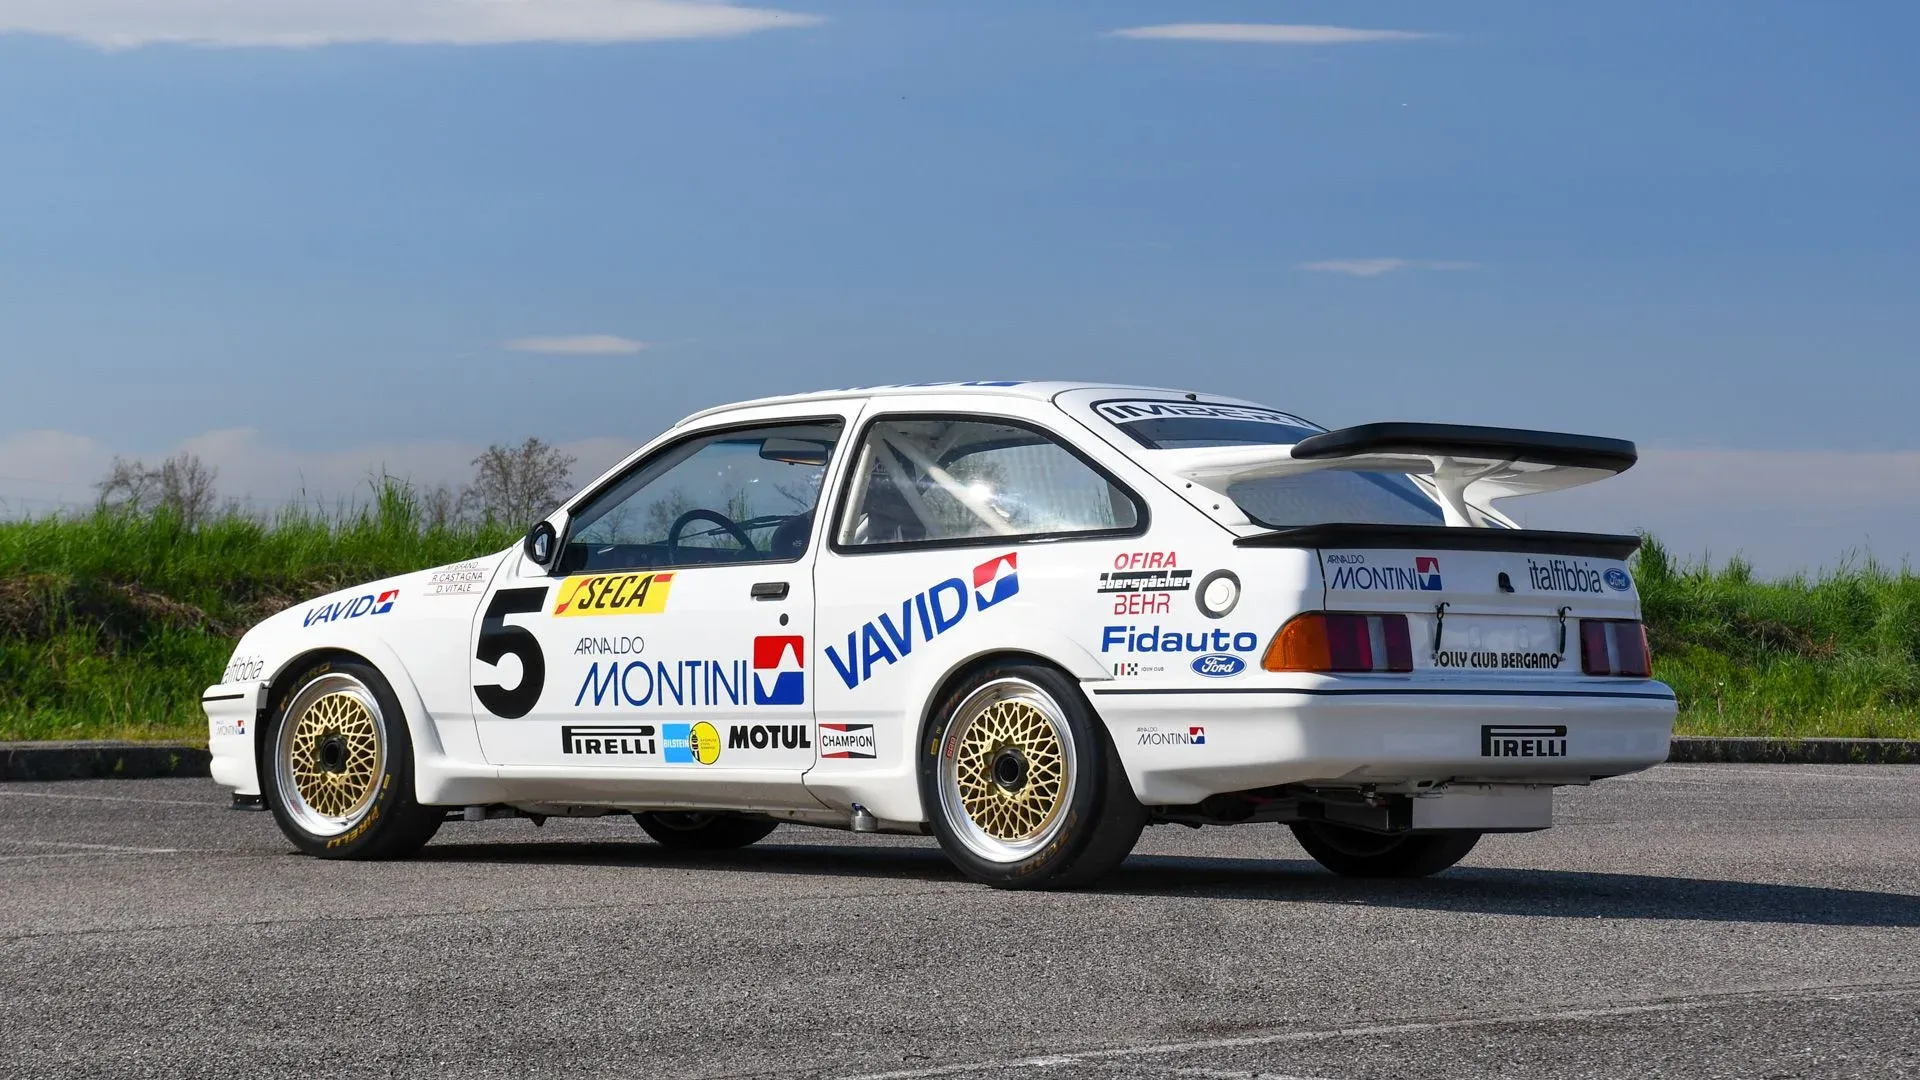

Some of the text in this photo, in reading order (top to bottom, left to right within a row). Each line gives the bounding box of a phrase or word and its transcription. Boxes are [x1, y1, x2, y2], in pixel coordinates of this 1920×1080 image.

[1114, 551, 1177, 570] OFIRA
[1326, 554, 1365, 564] ARNALDO
[1331, 566, 1418, 591] MONTINI
[1527, 558, 1604, 593] italfibbia
[577, 574, 655, 610] SECA
[1114, 593, 1171, 615] BEHR
[303, 594, 375, 628] VAVID
[574, 636, 645, 654] ARNALDO
[824, 577, 968, 690] VAVID
[1101, 625, 1258, 653] Fidauto
[473, 585, 550, 720] 5
[1470, 652, 1498, 669] CLUB
[1501, 652, 1560, 669] BERGAMO
[574, 660, 748, 707] MONTINI
[561, 725, 656, 755] PIRELLI
[728, 725, 812, 749] MOTUL
[822, 735, 873, 748] CHAMPION
[1137, 732, 1190, 746] MONTINI
[1481, 724, 1567, 757] PIRELLI
